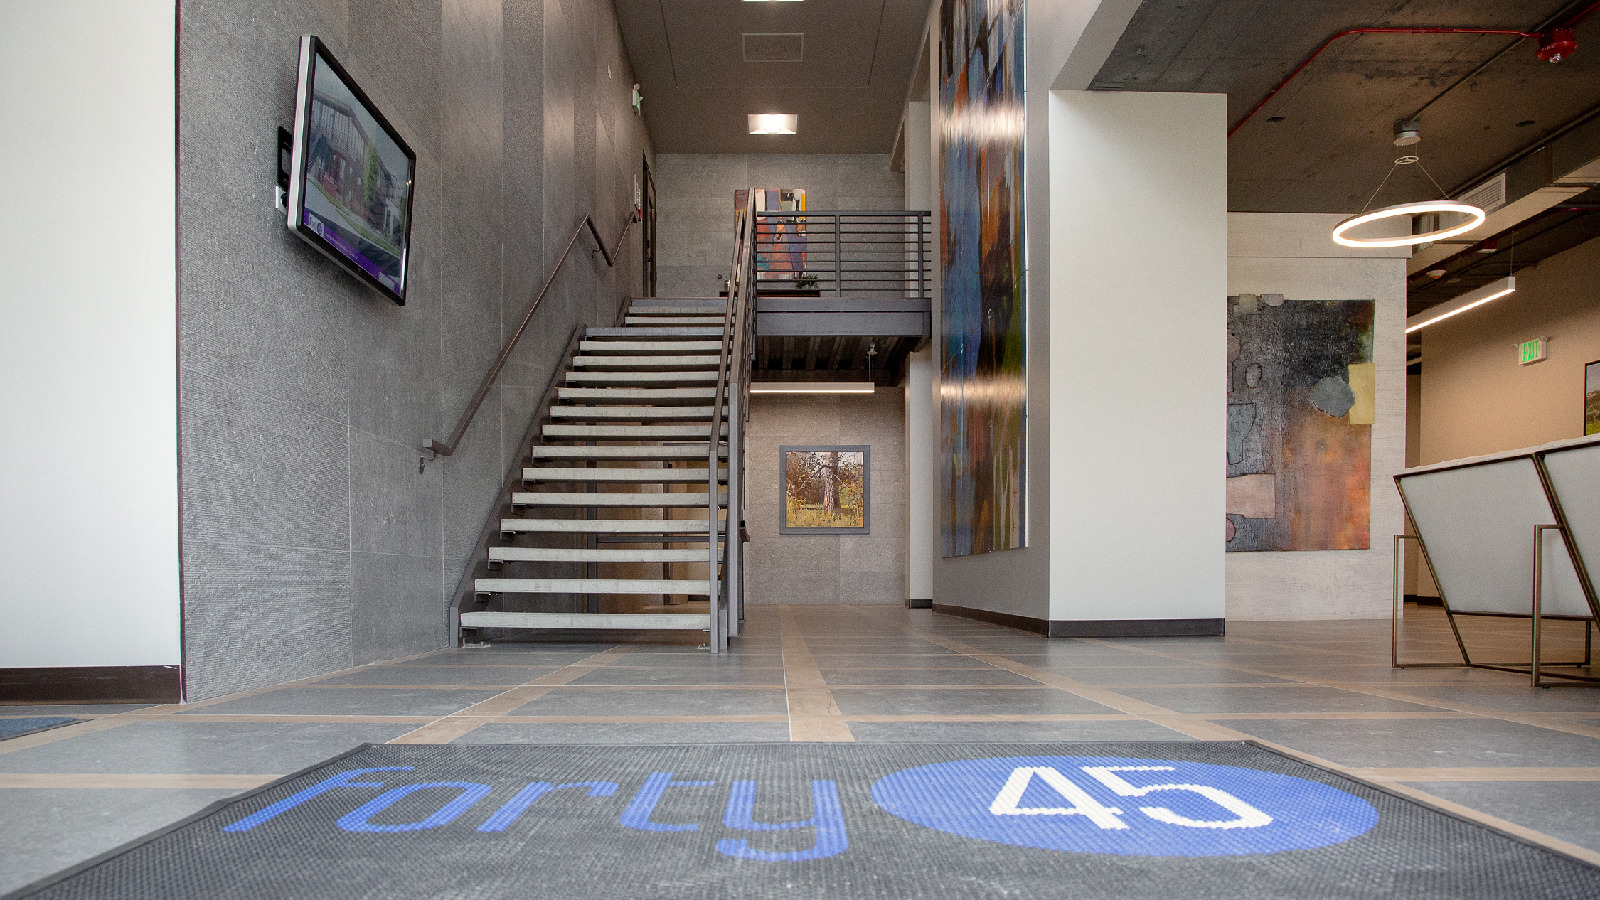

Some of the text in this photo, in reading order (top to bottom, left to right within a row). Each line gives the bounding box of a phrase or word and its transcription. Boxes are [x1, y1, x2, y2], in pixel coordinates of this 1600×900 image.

[1522, 339, 1539, 362] EXIT
[222, 766, 1274, 861] forty 45
